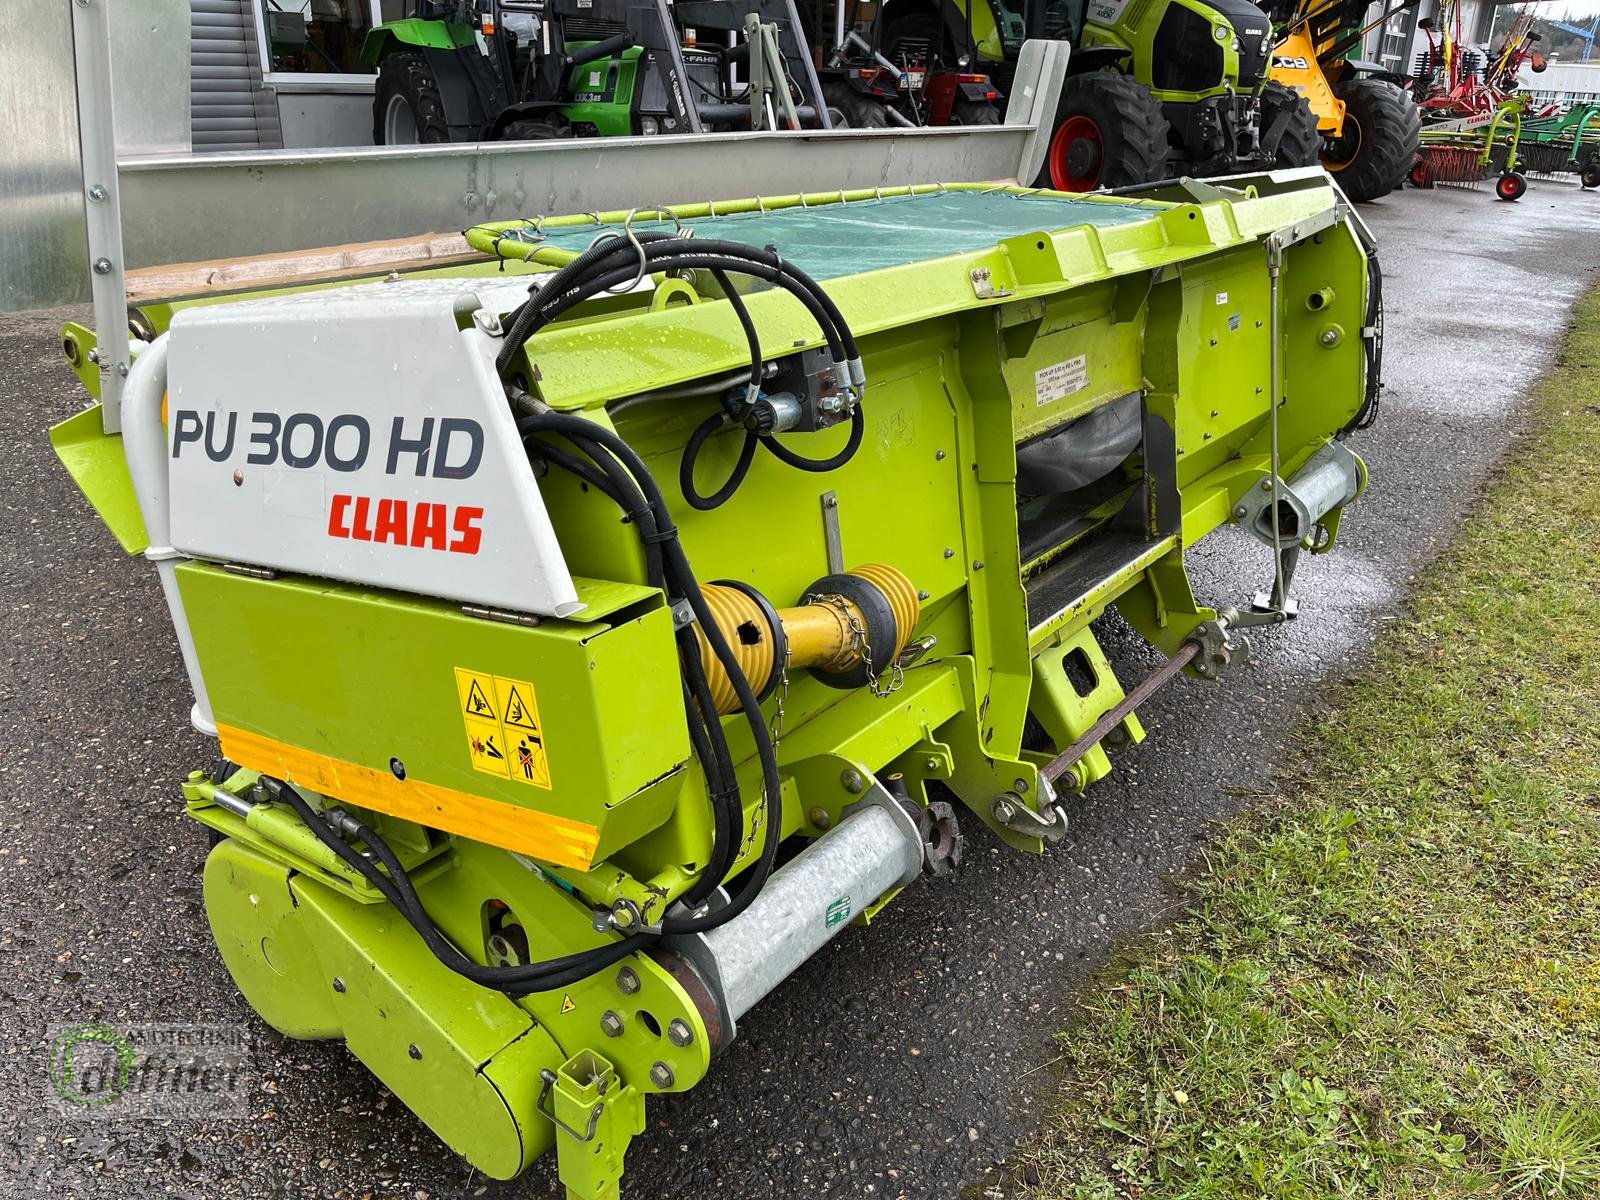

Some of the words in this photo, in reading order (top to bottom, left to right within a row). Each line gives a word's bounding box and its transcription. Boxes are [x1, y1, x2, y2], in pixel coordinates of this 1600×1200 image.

[1466, 115, 1490, 124] CLAAS
[172, 410, 238, 463] PU
[247, 412, 371, 472] 300
[385, 417, 485, 480] HD
[328, 494, 484, 555] CLAAS
